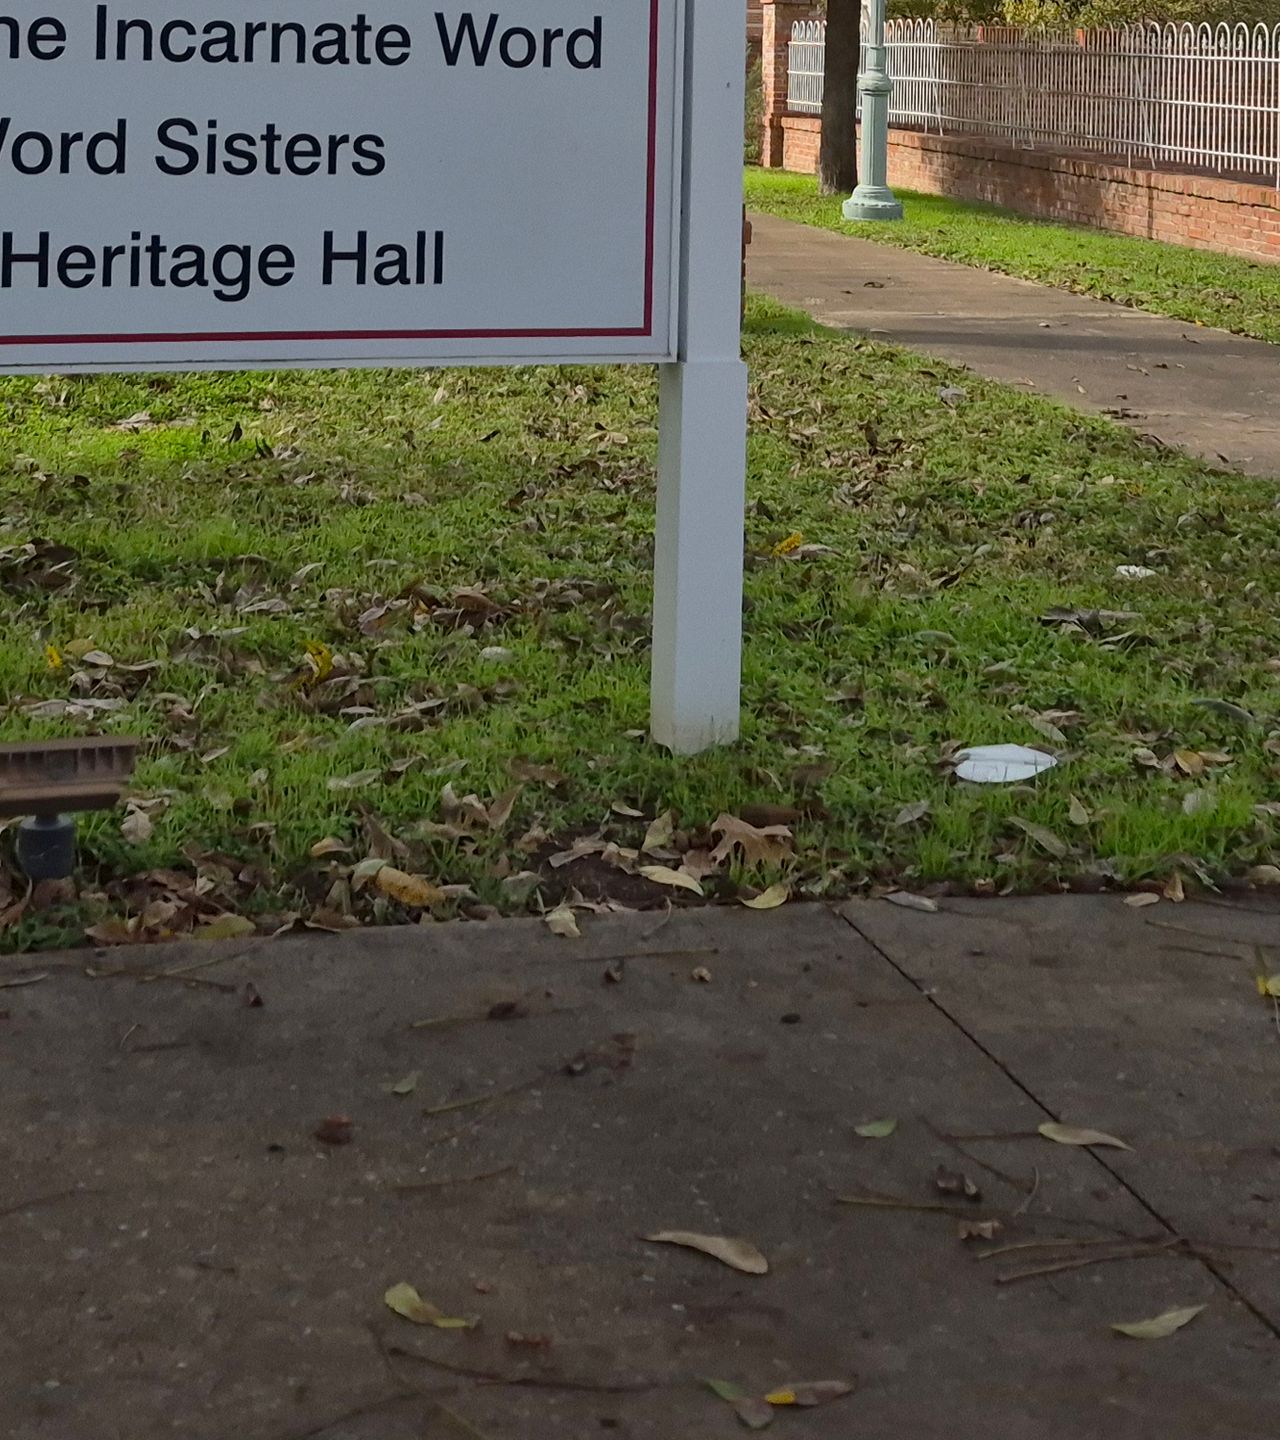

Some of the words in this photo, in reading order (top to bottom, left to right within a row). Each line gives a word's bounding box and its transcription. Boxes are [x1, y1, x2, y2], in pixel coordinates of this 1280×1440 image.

[95, 4, 411, 66] Incarnate
[434, 12, 602, 70] Word
[154, 117, 386, 177] Sisters
[1, 231, 296, 303] Heritage
[322, 230, 444, 286] Hall
